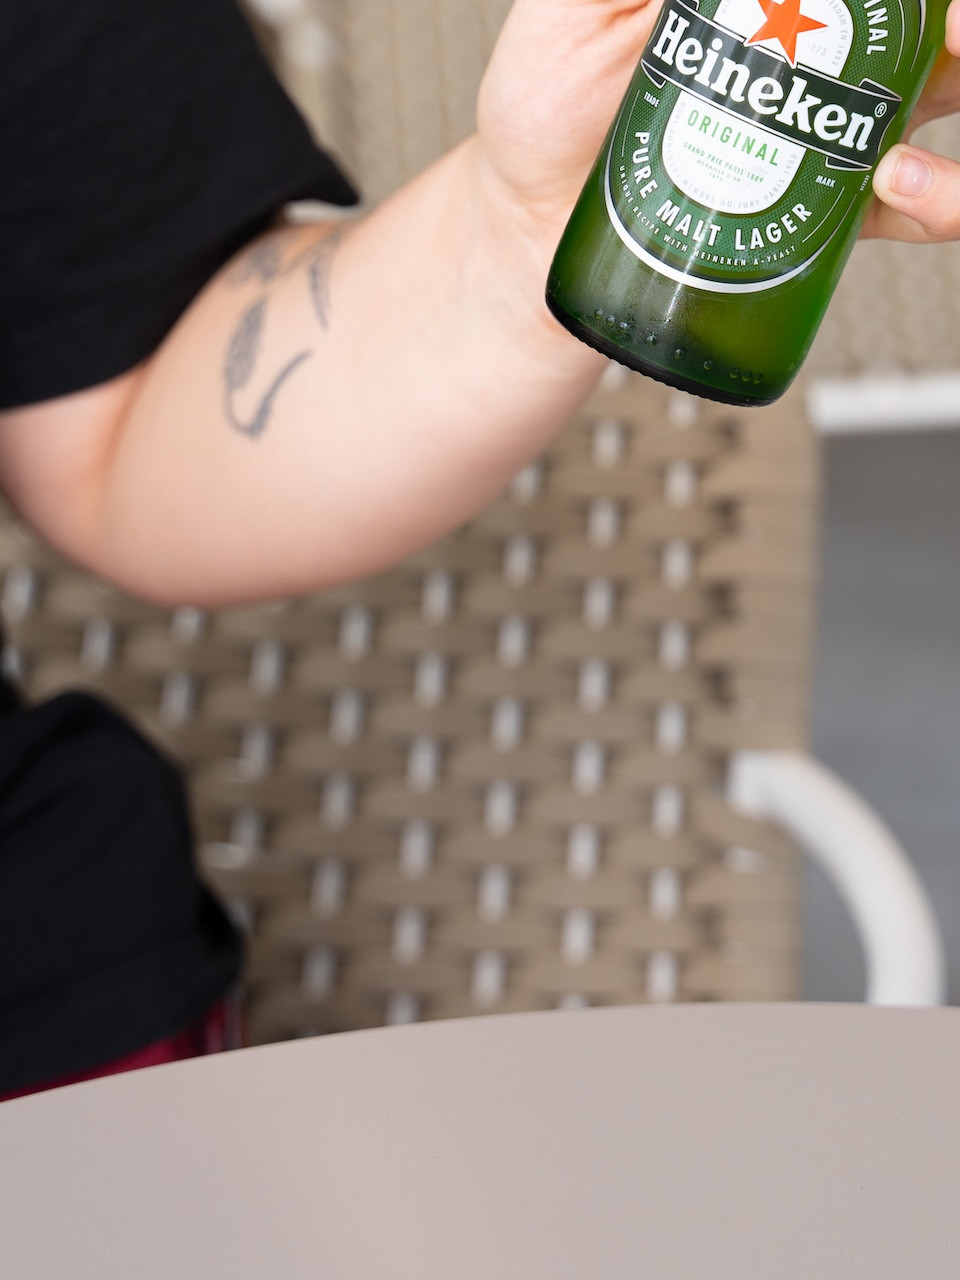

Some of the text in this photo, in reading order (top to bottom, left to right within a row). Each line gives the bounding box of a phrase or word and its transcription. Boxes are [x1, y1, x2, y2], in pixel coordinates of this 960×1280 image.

[643, 91, 660, 108] TRADE
[683, 141, 764, 183] GRAND PRIX PARIS 1889
[687, 109, 779, 166] ORIGINAL
[632, 131, 813, 251] PURE MALT LAGER
[815, 175, 836, 188] MARK
[619, 165, 796, 267] UNIQUE RECIPE WITH HEINEKEN A-YEAST
